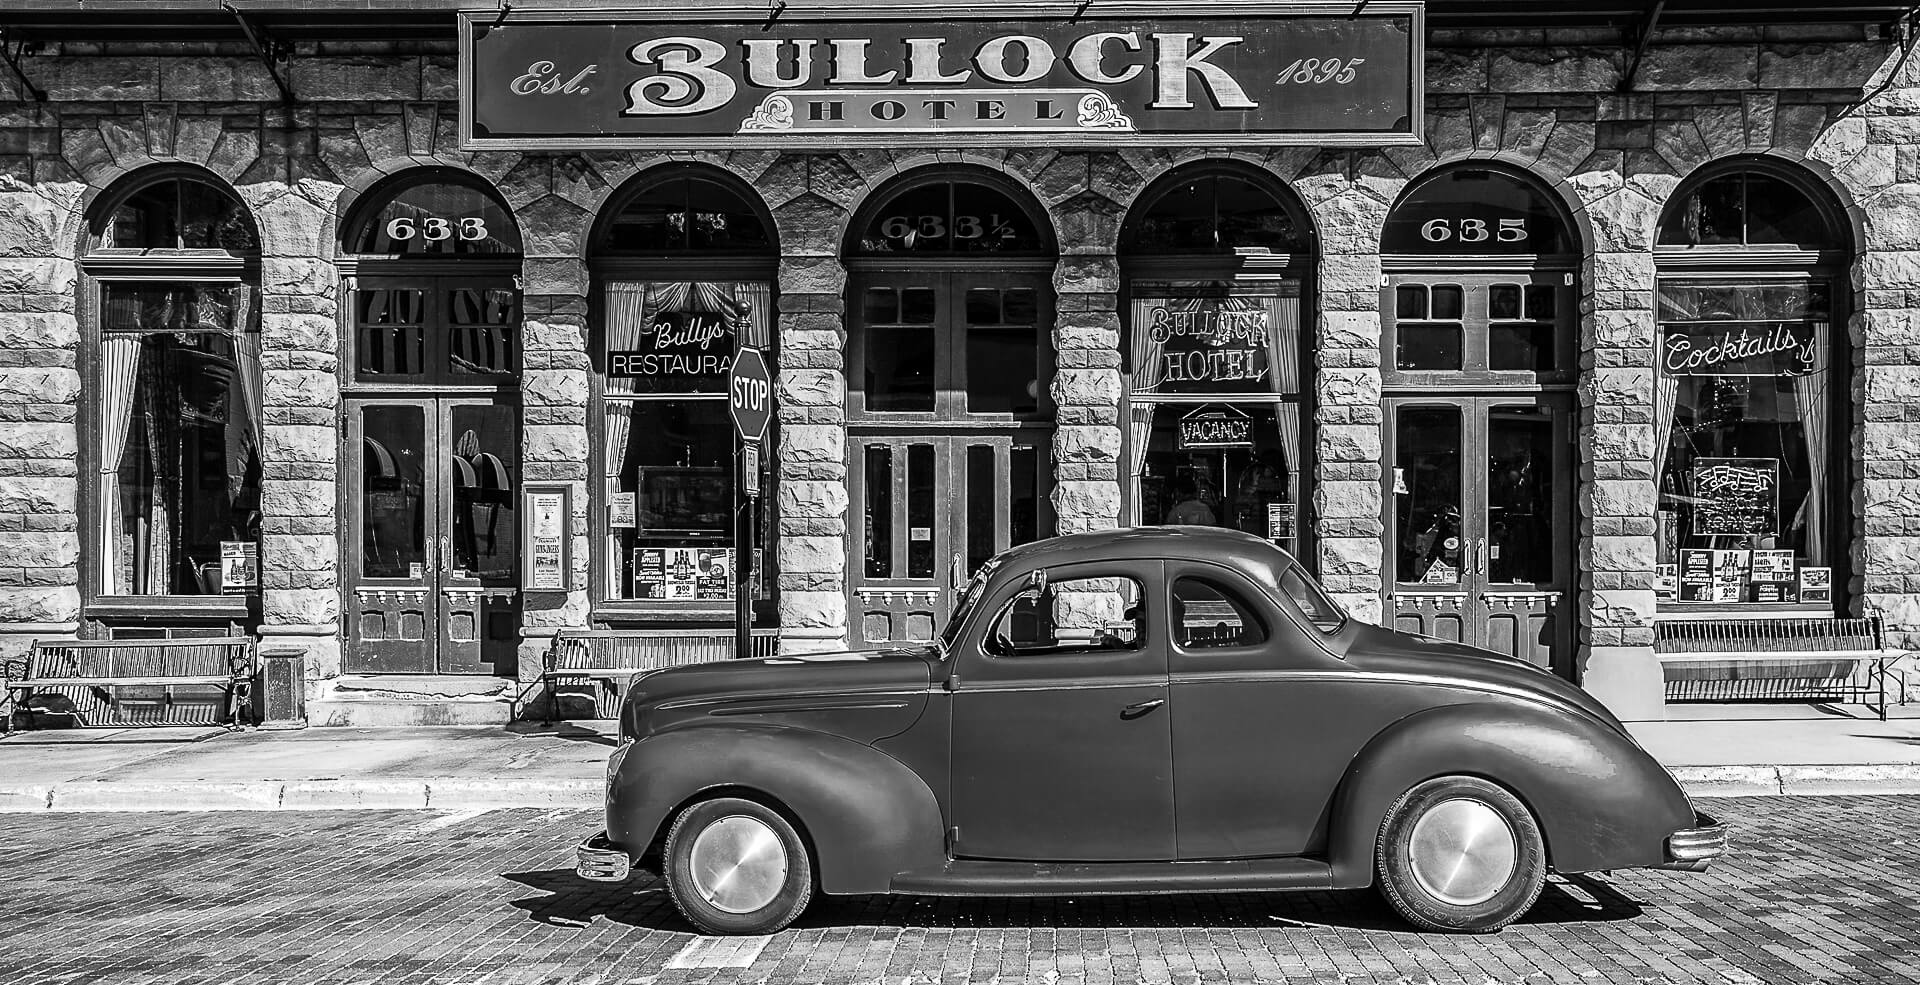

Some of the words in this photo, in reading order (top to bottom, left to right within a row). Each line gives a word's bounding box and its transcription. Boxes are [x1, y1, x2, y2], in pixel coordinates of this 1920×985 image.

[510, 60, 597, 97] Est.
[619, 31, 1260, 117] BULLOCK
[1275, 57, 1365, 85] 1895
[807, 99, 1066, 121] HOTEL
[386, 216, 489, 241] 633
[1421, 218, 1528, 242] 635
[653, 316, 725, 350] Bullys
[1151, 308, 1269, 348] BULLOCK
[1666, 323, 1799, 370] Cocktails
[612, 354, 731, 375] RESTAURA
[1164, 349, 1262, 382] HOTEL
[733, 375, 768, 412] STOP
[1181, 421, 1250, 440] VACANCY
